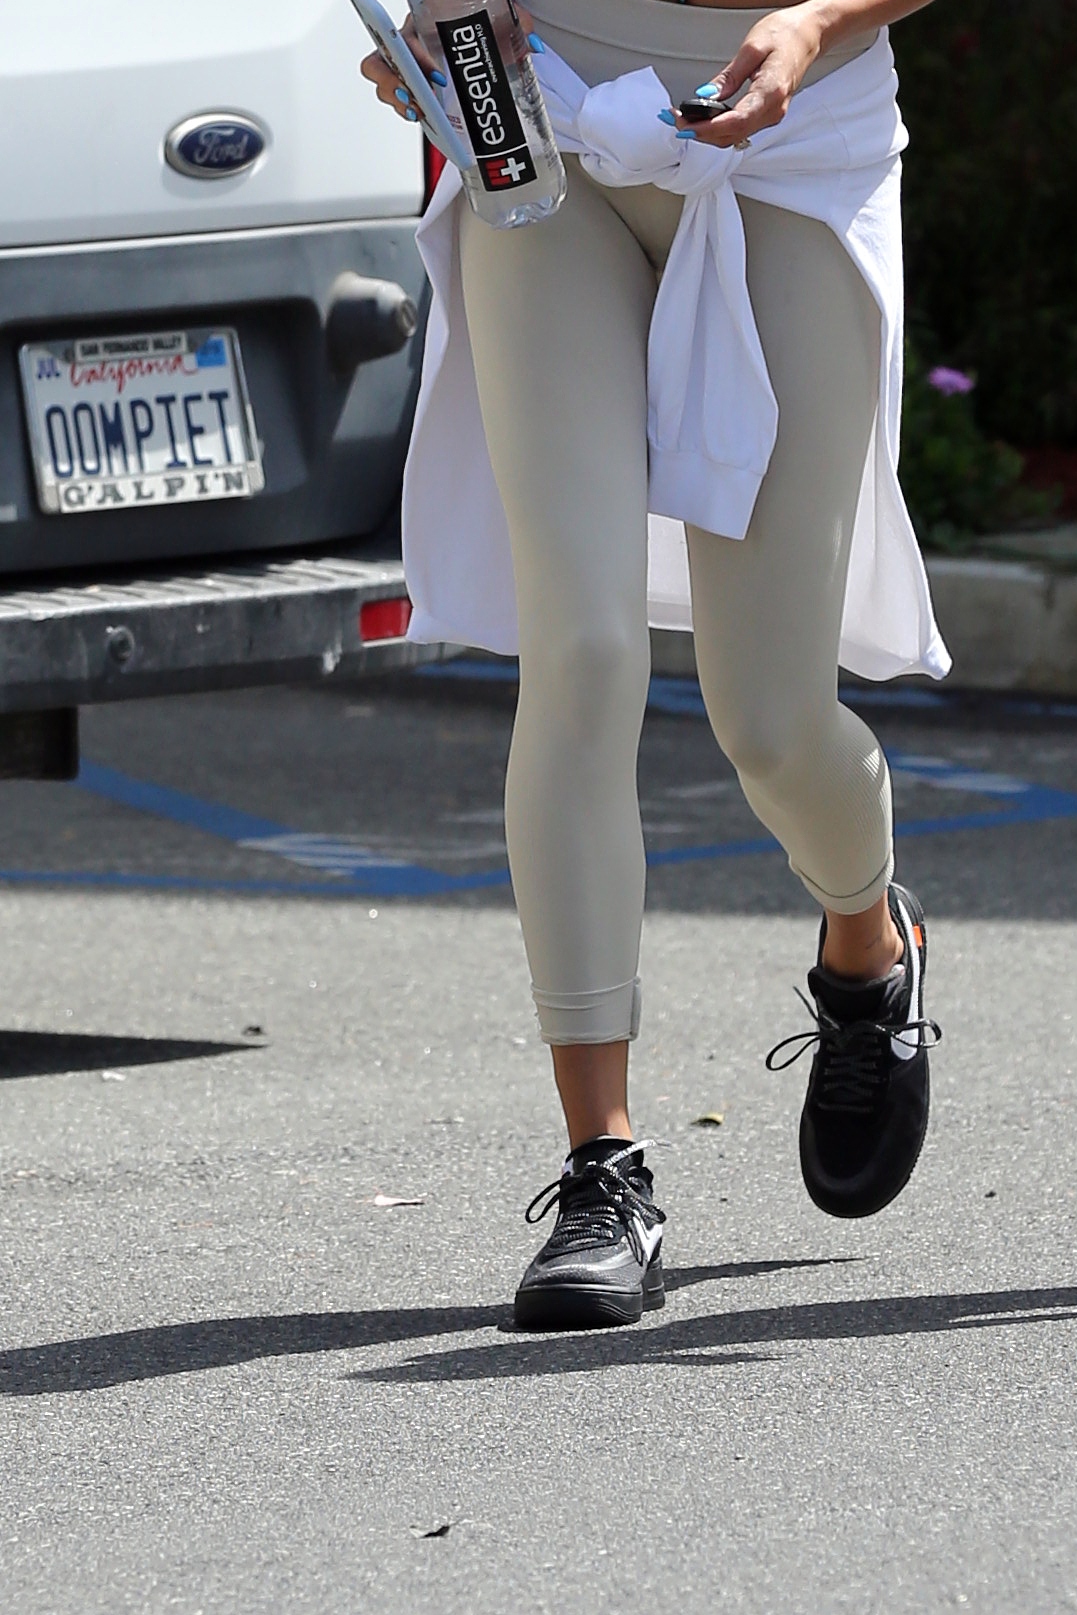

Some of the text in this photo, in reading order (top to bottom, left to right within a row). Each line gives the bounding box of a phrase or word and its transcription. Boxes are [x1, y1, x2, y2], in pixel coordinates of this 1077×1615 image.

[452, 24, 505, 146] essentia
[194, 128, 249, 163] Ford
[70, 354, 199, 393] California
